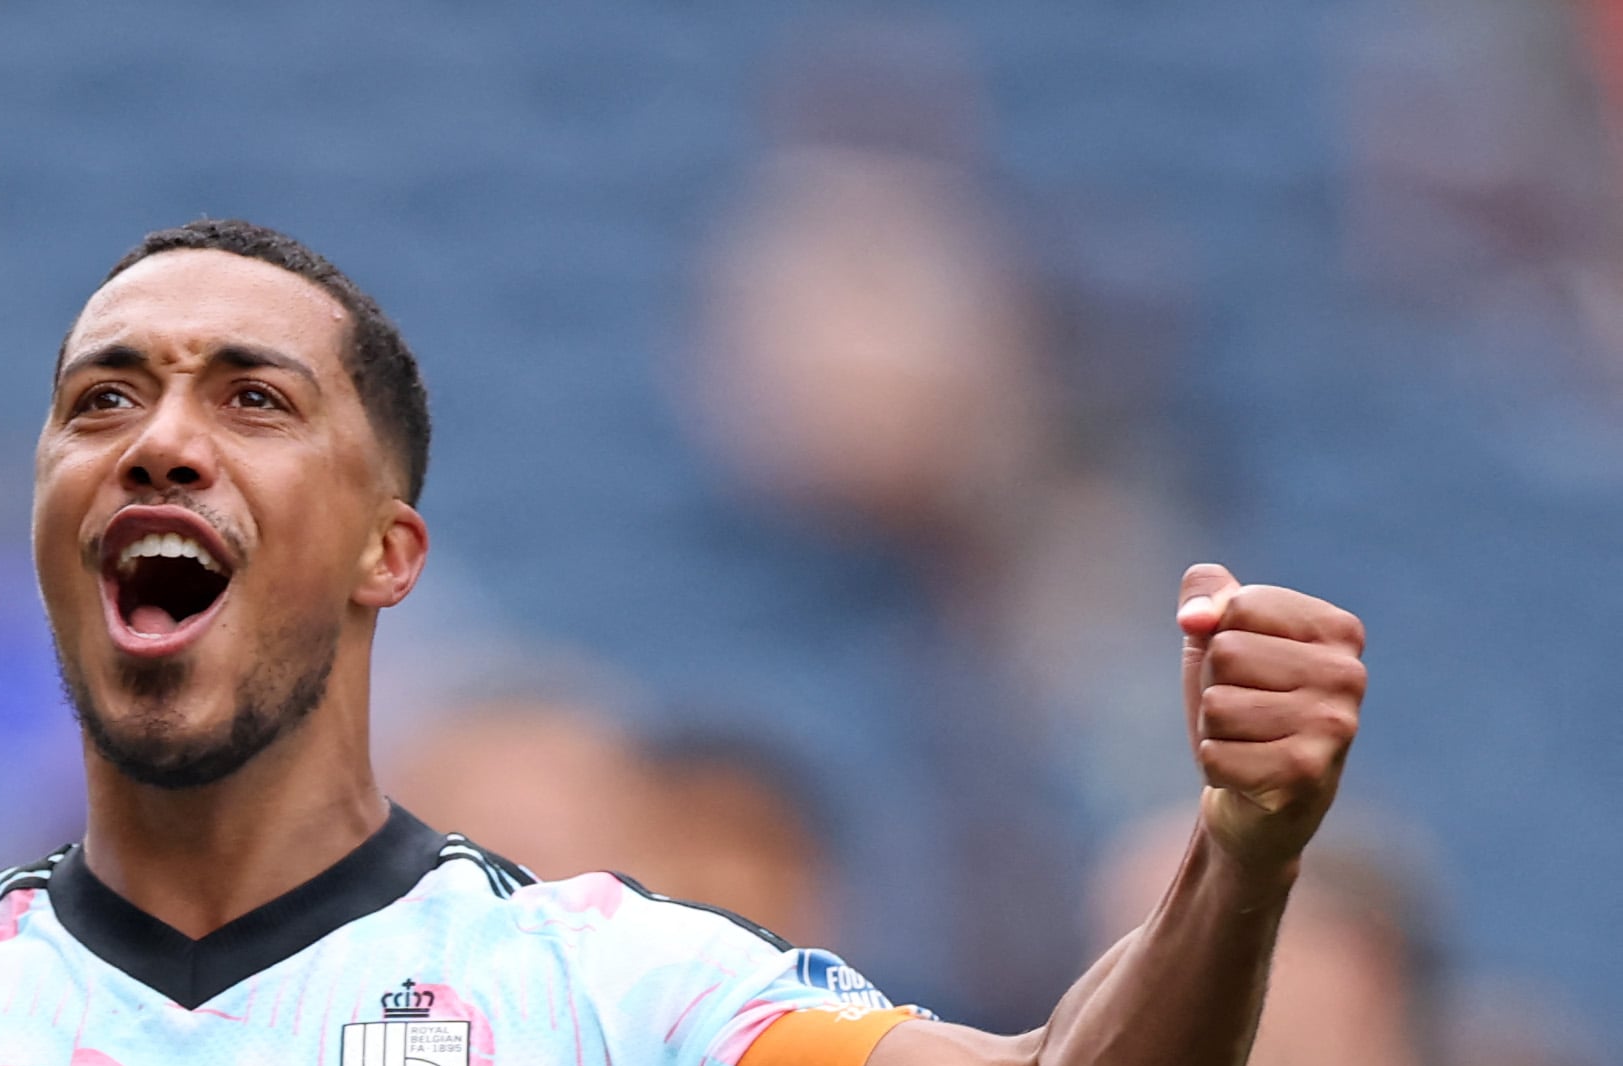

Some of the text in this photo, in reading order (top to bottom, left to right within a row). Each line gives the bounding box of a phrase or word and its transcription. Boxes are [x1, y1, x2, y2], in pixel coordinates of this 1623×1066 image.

[410, 1026, 449, 1034] ROYAL
[410, 1035, 463, 1043] BELGIAN
[410, 1044, 463, 1053] FA 1895
